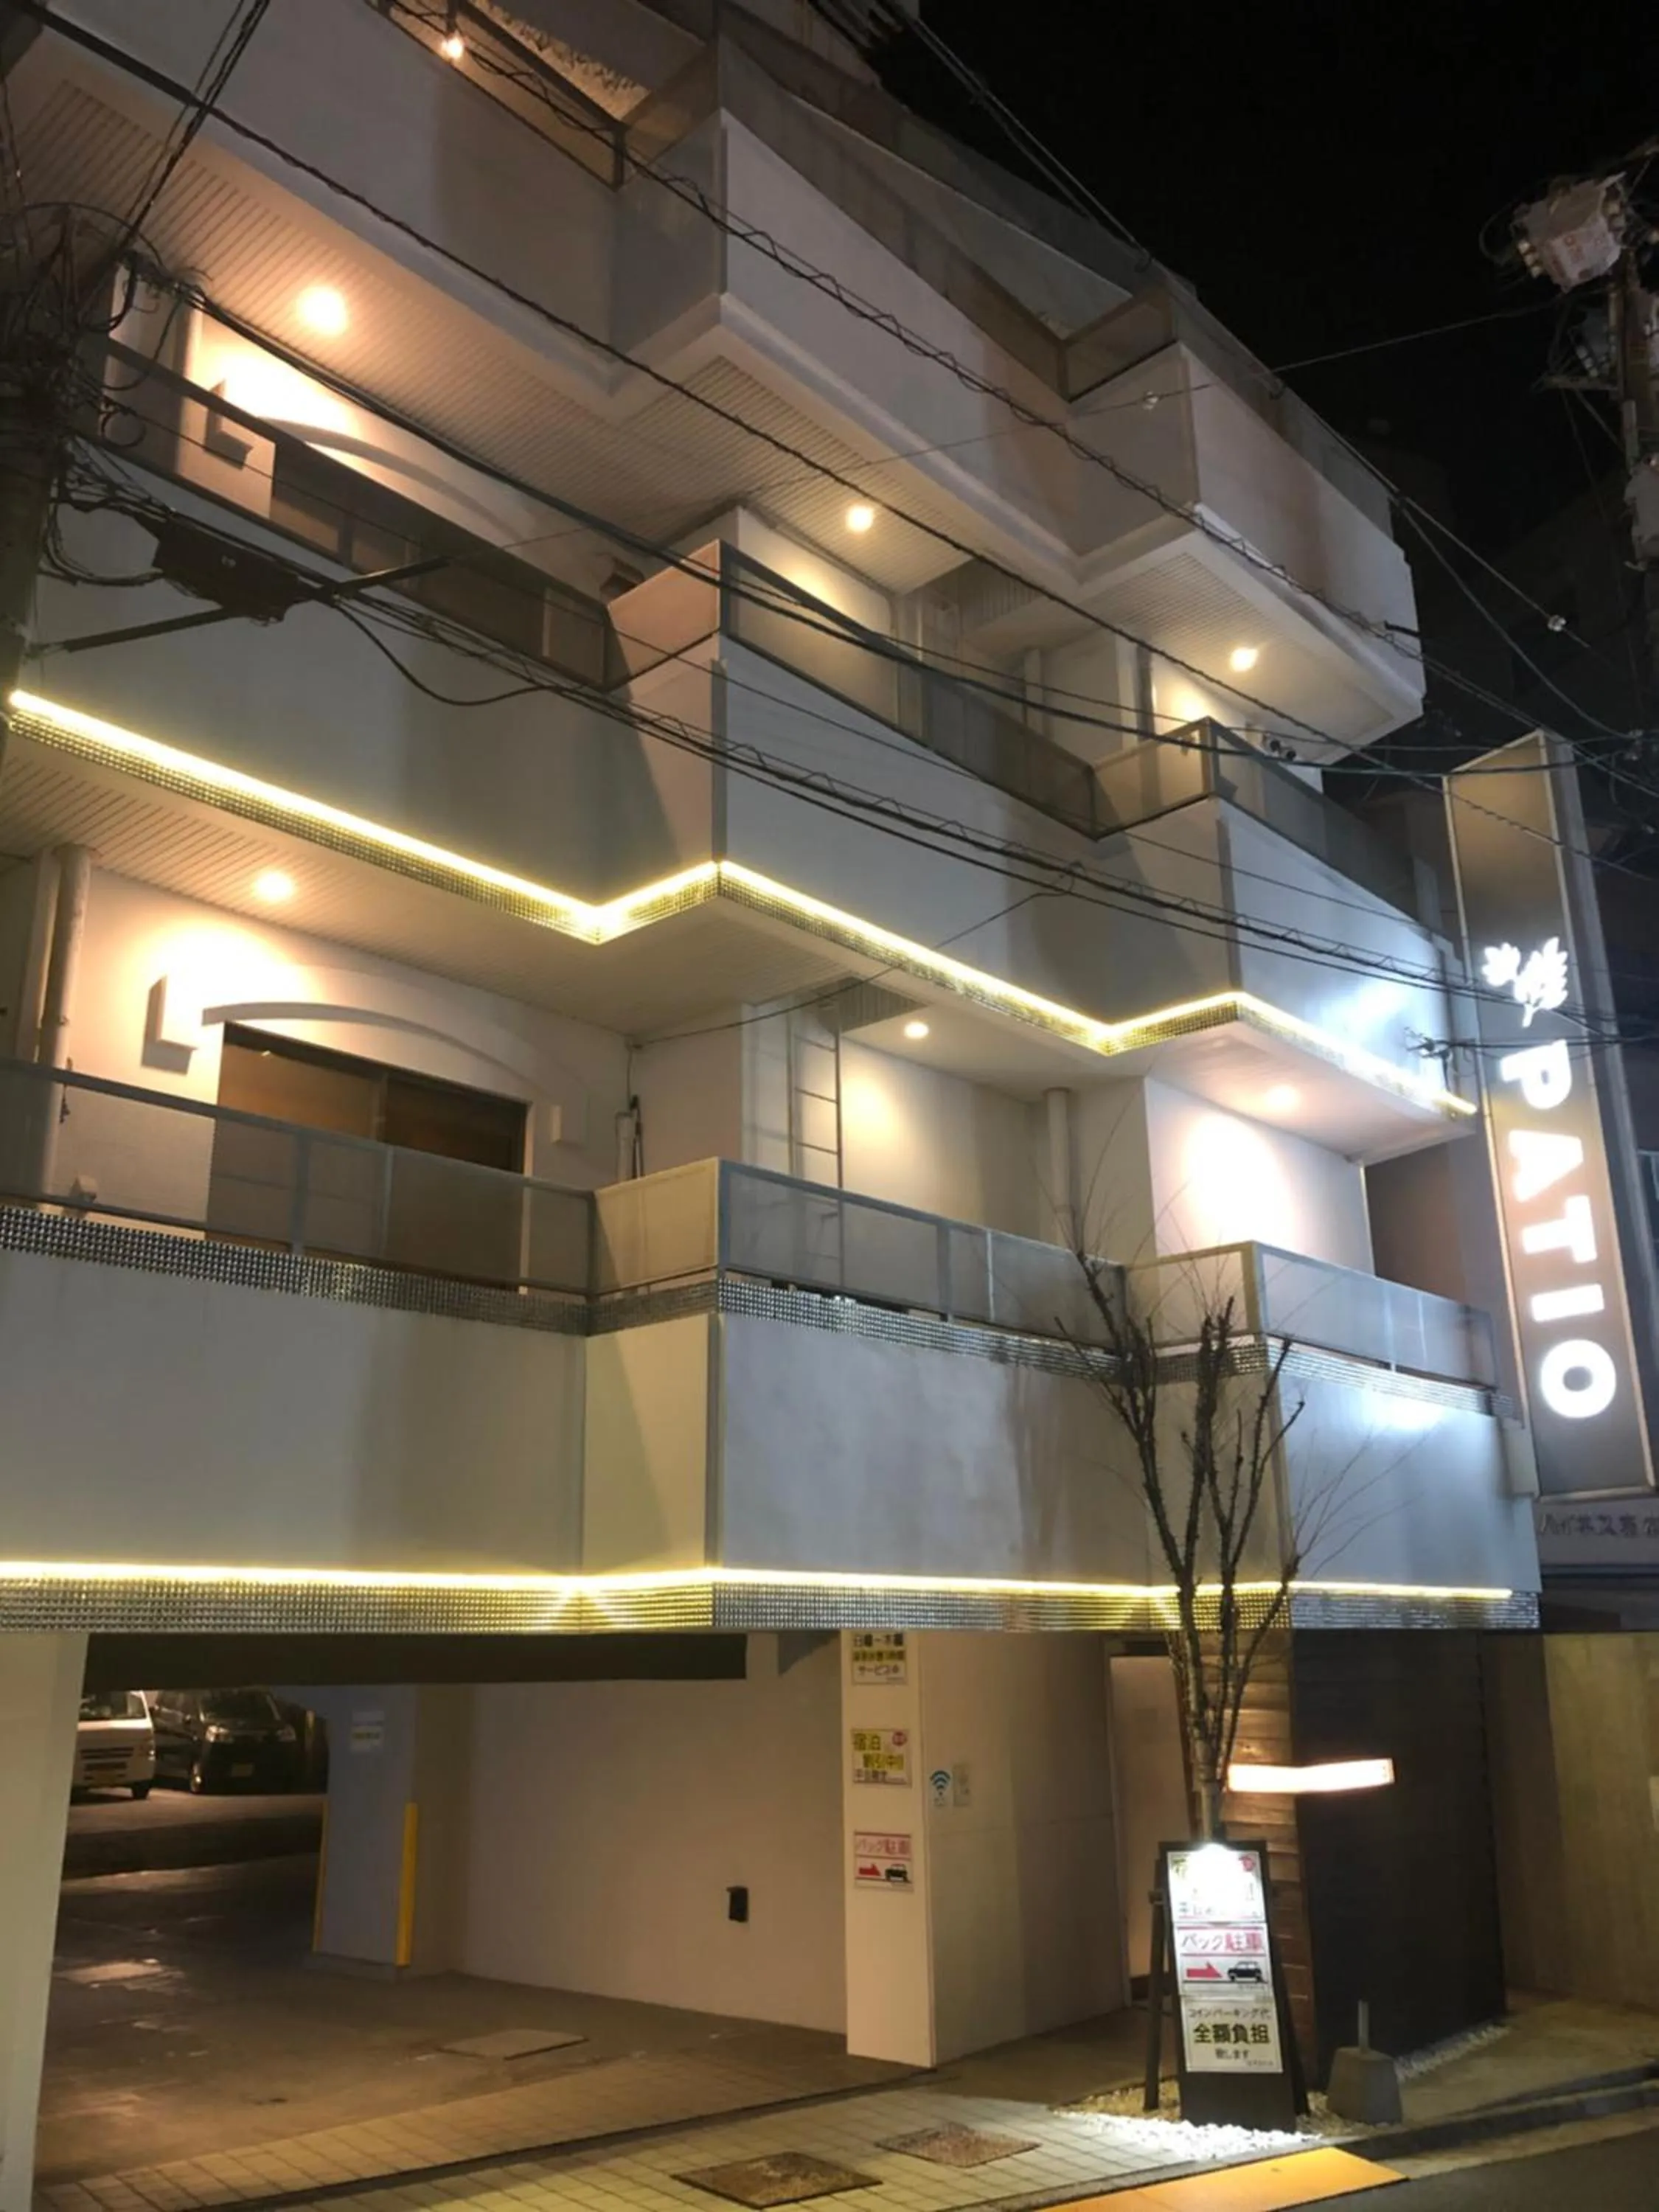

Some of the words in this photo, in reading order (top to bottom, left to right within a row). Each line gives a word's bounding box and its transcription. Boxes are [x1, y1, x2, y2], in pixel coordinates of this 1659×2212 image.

[1500, 1040, 1616, 1419] PATIO
[1193, 2023, 1270, 2045] 全額負担
